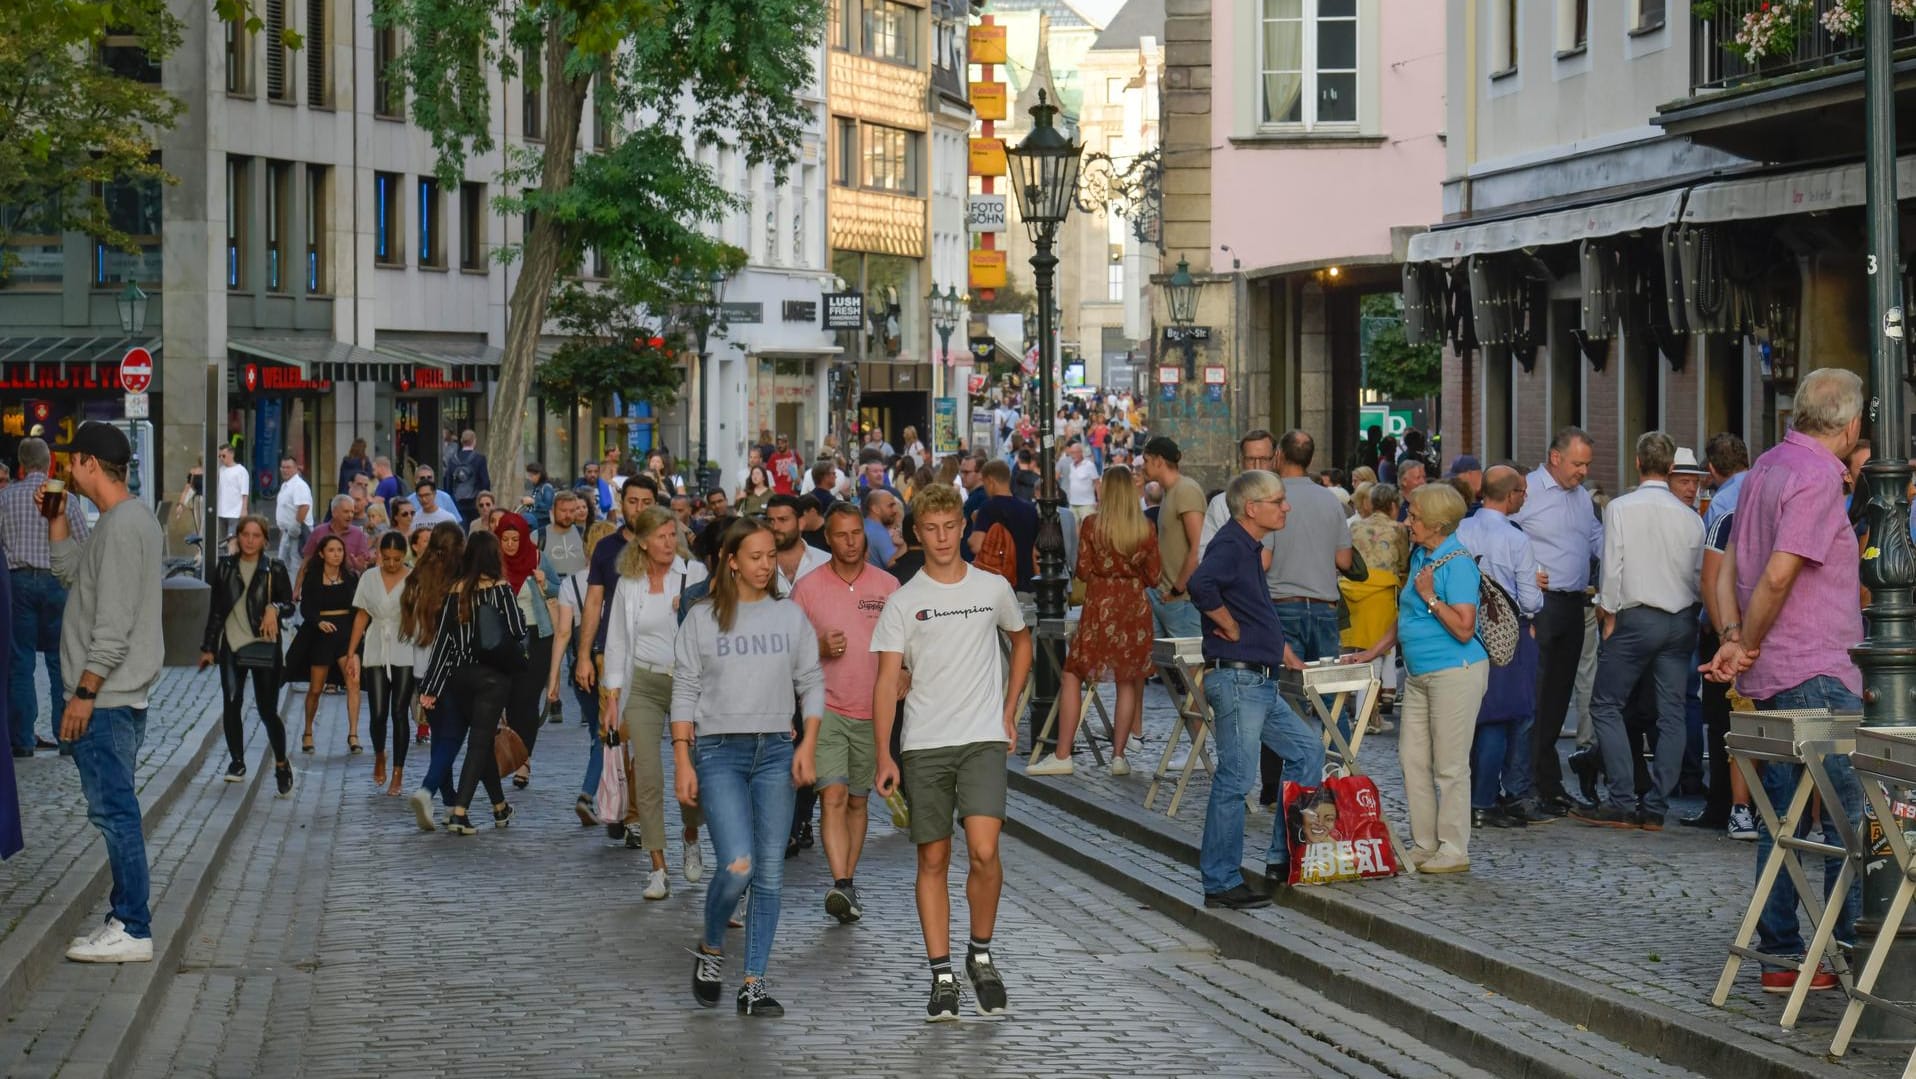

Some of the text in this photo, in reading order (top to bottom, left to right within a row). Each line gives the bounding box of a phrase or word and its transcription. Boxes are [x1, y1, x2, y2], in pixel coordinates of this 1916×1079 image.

[971, 202, 1004, 213] FOTO
[1867, 254, 1878, 275] 3
[829, 297, 861, 306] LUSH
[829, 306, 861, 315] FRESH
[551, 534, 577, 560] ck
[915, 604, 994, 622] Champion
[716, 632, 790, 656] BONDI
[1305, 838, 1383, 860] #BEST
[1301, 855, 1390, 879] #DEAL
